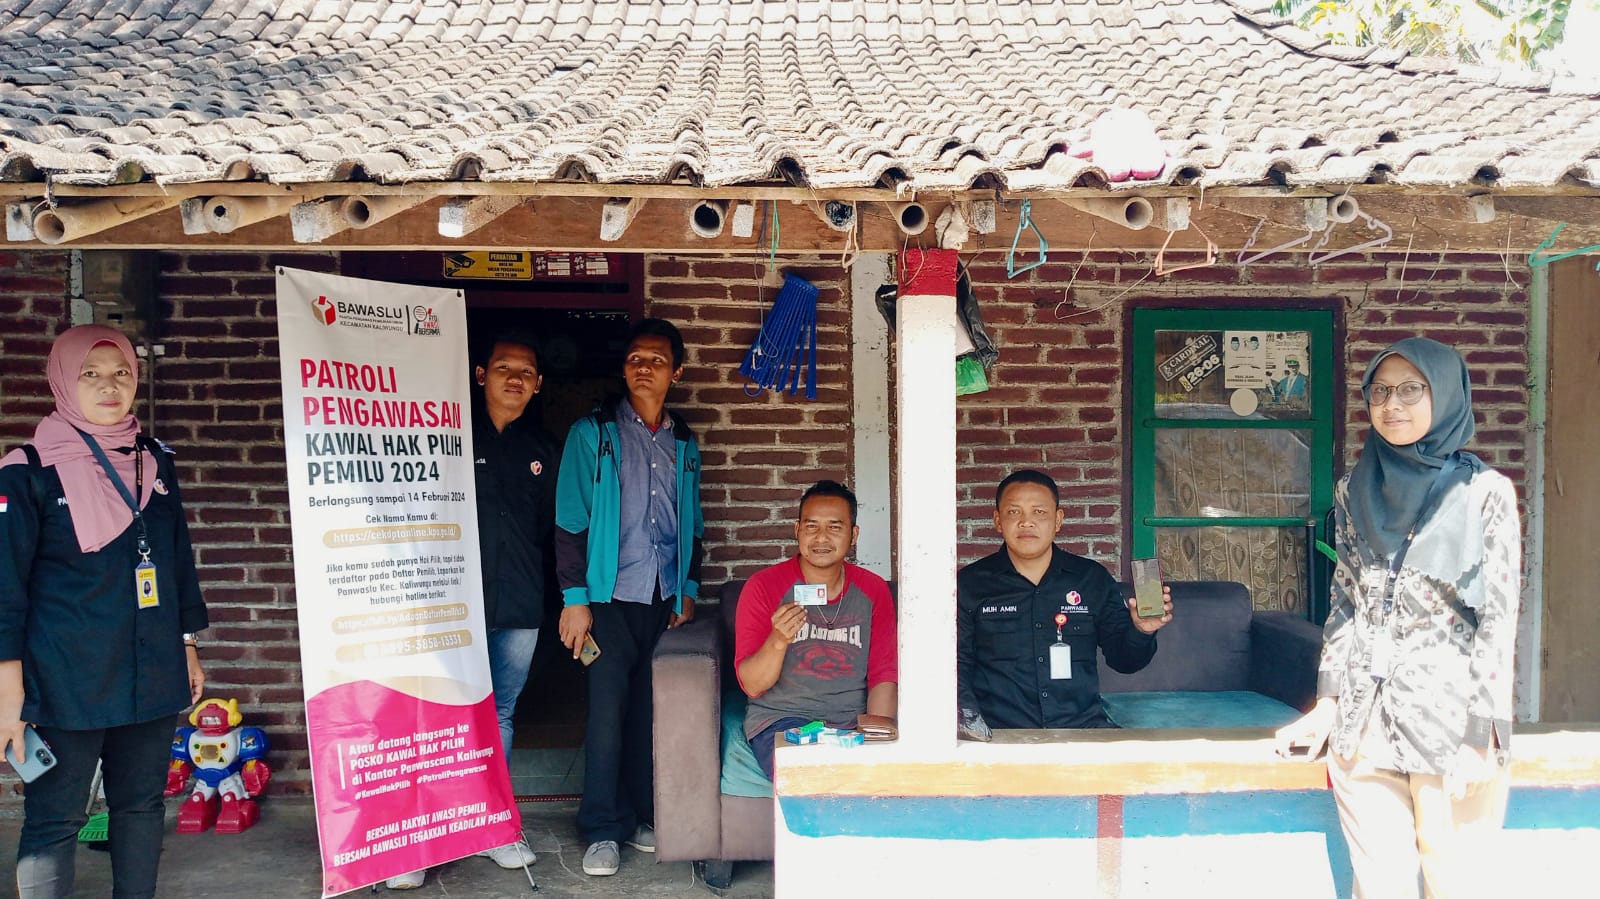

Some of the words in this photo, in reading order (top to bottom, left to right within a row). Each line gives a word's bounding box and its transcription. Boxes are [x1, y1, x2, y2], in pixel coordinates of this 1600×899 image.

[338, 302, 402, 318] BAWASLU
[1170, 337, 1210, 367] CARDINAL
[300, 359, 397, 393] PATROLI
[303, 397, 461, 429] PENGAWASAN
[306, 433, 377, 456] KAWAL
[382, 435, 422, 456] HAK
[427, 434, 462, 456] PILIH
[308, 461, 384, 485] PEMILU
[391, 461, 439, 482] 2024
[309, 495, 373, 507] Berlangsung
[376, 494, 406, 504] sampai
[408, 493, 419, 501] 14
[422, 492, 449, 501] Februari
[451, 492, 465, 501] 2024
[366, 514, 381, 523] Cek
[384, 514, 404, 522] Nama
[407, 513, 428, 521] Kamu
[430, 512, 438, 520] di:
[326, 564, 342, 573] Jika
[346, 562, 368, 570] kamu
[371, 559, 395, 569] sudah
[397, 558, 418, 568] punya
[420, 556, 429, 564] Hak
[328, 574, 366, 585] terdaftar
[370, 573, 390, 582] pada
[392, 569, 414, 578] Daftar
[337, 586, 377, 596] Panwaslu
[380, 584, 397, 592] Kec.
[400, 581, 431, 590] Kaliwungu
[370, 596, 403, 605] hubungi
[406, 593, 427, 601] hotline
[349, 744, 374, 755] Atau
[378, 735, 410, 750] datang
[413, 727, 454, 743] langsung
[457, 724, 469, 732] ke
[351, 757, 383, 771] POSKO
[387, 750, 416, 762] KAWAL
[420, 744, 438, 755] HAK
[441, 738, 464, 750] PILIH
[352, 774, 362, 785] di
[365, 768, 397, 781] Kantor
[400, 757, 454, 773] Panwascam
[457, 747, 494, 762] Kaliwungu
[355, 780, 410, 800] #KawalHakPilih
[416, 765, 487, 784] #PatroliPengawasan
[366, 822, 400, 841] BERSAMA
[402, 814, 430, 830] RAKYAT
[432, 810, 455, 823] AWASI
[458, 802, 486, 817] PEMILU
[334, 847, 370, 866] BERSAMA
[372, 836, 407, 855] BAWASLU
[409, 825, 446, 844] TEGAKKAN
[449, 815, 486, 834] KEADILAN
[488, 809, 512, 825] PEMILU
